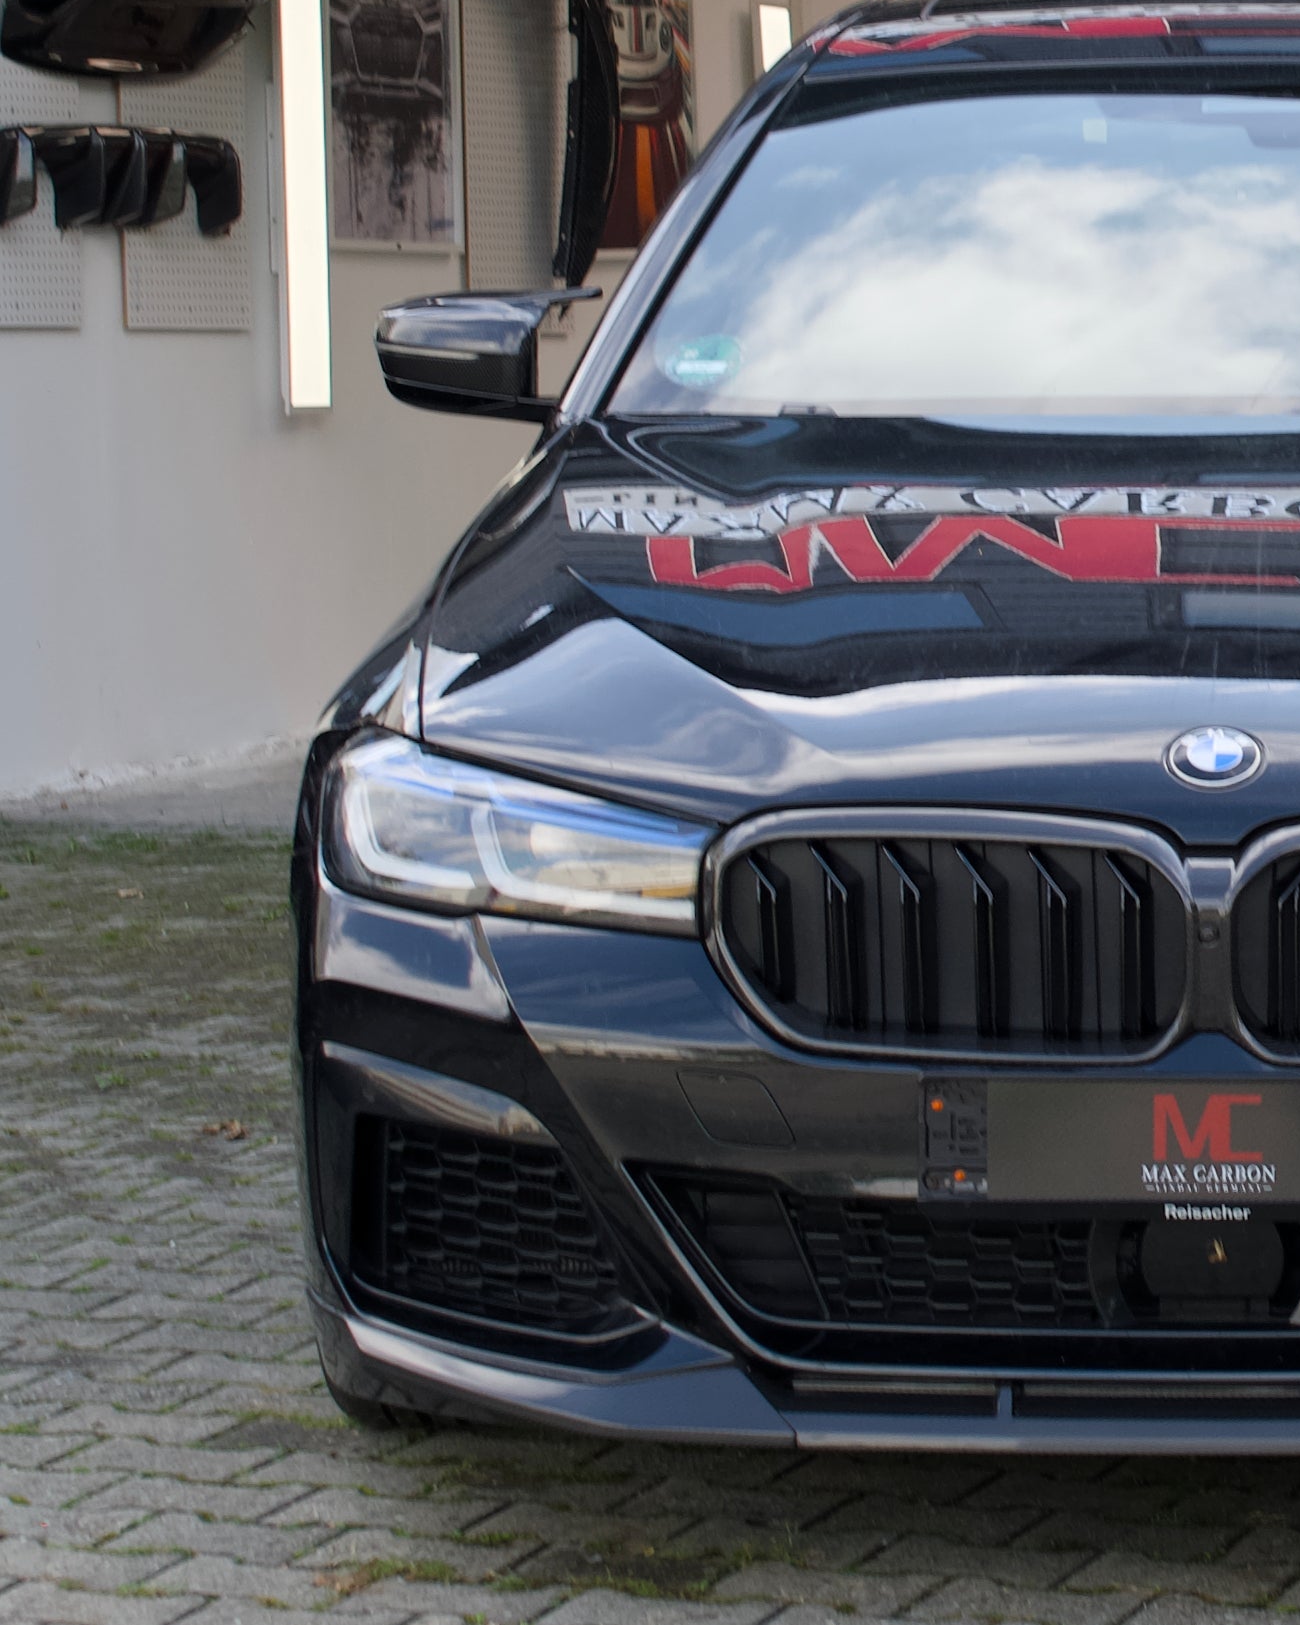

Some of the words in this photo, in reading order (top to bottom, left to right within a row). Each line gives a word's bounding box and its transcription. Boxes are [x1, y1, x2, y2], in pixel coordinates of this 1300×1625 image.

[1153, 1094, 1263, 1162] MC
[1141, 1164, 1187, 1183] MAX
[1193, 1164, 1276, 1183] CARBON
[1164, 1203, 1251, 1221] Reisacher
